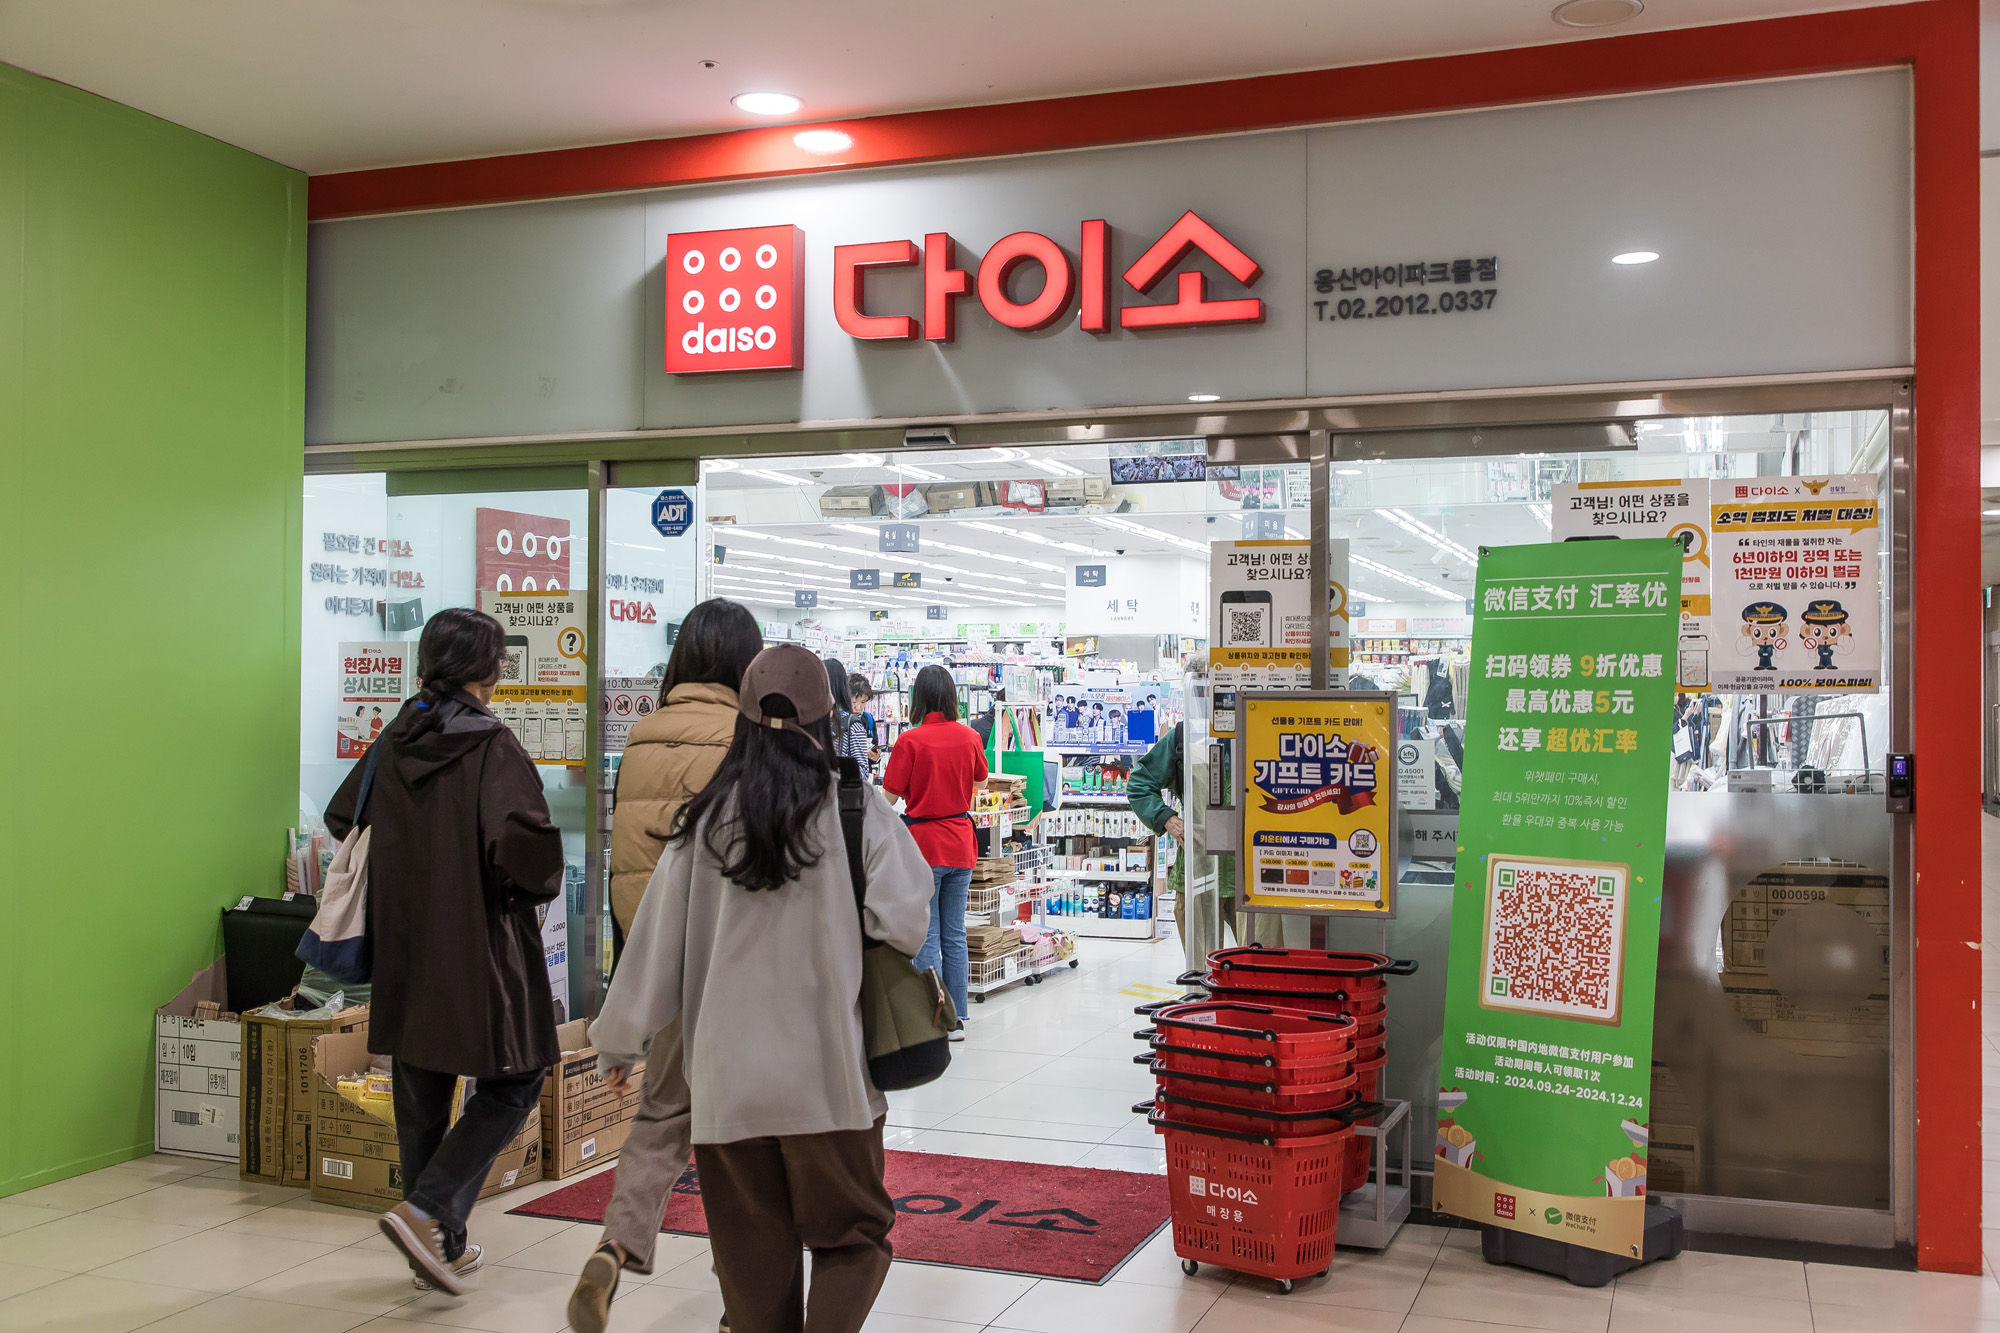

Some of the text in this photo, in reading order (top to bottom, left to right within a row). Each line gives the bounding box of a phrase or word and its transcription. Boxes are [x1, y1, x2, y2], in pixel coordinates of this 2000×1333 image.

[833, 209, 1266, 343] 다이소
[1313, 256, 1498, 294] 용산아이파크몰점
[1313, 289, 1498, 322] T.02.2012.0337
[682, 322, 777, 354] daiso
[1751, 486, 1789, 496] 다이소
[1570, 493, 1689, 510] 고객님! 어떤 상품을
[658, 504, 687, 521] ADT
[1592, 511, 1667, 525] 찾으시나요?
[1716, 507, 1874, 524] 소액 범죄도 처벌 대상!
[323, 532, 360, 554] 필요한
[363, 537, 376, 555] 건
[1753, 537, 1842, 547] 타인의 재물을 절취한 자는
[1227, 554, 1266, 566] 고객님!
[1270, 553, 1292, 565] 어떤
[1733, 549, 1862, 564] 6년이하의 징역 또는
[310, 562, 425, 588] 원하는 가격에 다있소
[1247, 568, 1311, 581] 찾으시나요?
[1734, 565, 1861, 580] 1천만원 이하의 벌금
[1749, 582, 1843, 591] 으로 처벌 받을 수 있습니다.
[1483, 581, 1668, 612] 微信支付 汇率优
[325, 596, 373, 616] 어디든지
[494, 602, 574, 614] 고객님! 어떤 상품을
[610, 600, 657, 624] 다이소
[1107, 599, 1138, 613] 세탁
[509, 615, 559, 626] 찾으시나요?
[1228, 652, 1287, 660] 상품위치와 재고현황
[344, 657, 402, 675] 현장사원
[1485, 653, 1663, 679] 扫码领券 9折优惠
[344, 677, 402, 694] 상시모집
[607, 680, 632, 688] 10:00
[1779, 678, 1872, 687] 100% 보이스피싱!
[1506, 688, 1634, 714] 最高优惠5元
[606, 724, 628, 732] CCTV
[1271, 717, 1363, 726] 선물용 기프트 카드 판매!
[1280, 735, 1347, 758] 다이소
[1498, 727, 1638, 754] 还享 超优汇率
[1255, 762, 1375, 786] 기프트 카드
[1525, 770, 1600, 785] 위챗페이 구매시,
[1277, 803, 1296, 811] 감사의
[1492, 791, 1628, 810] 최대 5위안까지 10%즉시 할인
[1502, 813, 1624, 832] 환율 우대와 중복 사용 가능
[1260, 834, 1330, 846] 카운터에서 구매가능
[1432, 830, 1458, 842] 주시
[1771, 889, 1826, 901] 0000598
[182, 1044, 196, 1062] 10입
[1466, 1032, 1634, 1069] 活动仅限中国内地微信支付用户参加
[160, 1068, 178, 1085] 제조일자
[299, 1047, 309, 1095] 1011706
[1494, 1054, 1601, 1083] 活动期间每人可领取1次
[1454, 1066, 1643, 1109] 活动时间： 2024.09.24-2024.12.24
[339, 1124, 351, 1135] 10입
[296, 1154, 303, 1164] 12
[1209, 1182, 1258, 1205] 다이소
[894, 1194, 1100, 1235] 이소
[1206, 1205, 1243, 1222] 매장용
[1496, 1208, 1513, 1217] daiso
[1565, 1212, 1596, 1226] 微信支付
[1565, 1222, 1596, 1234] WeChat Pay
